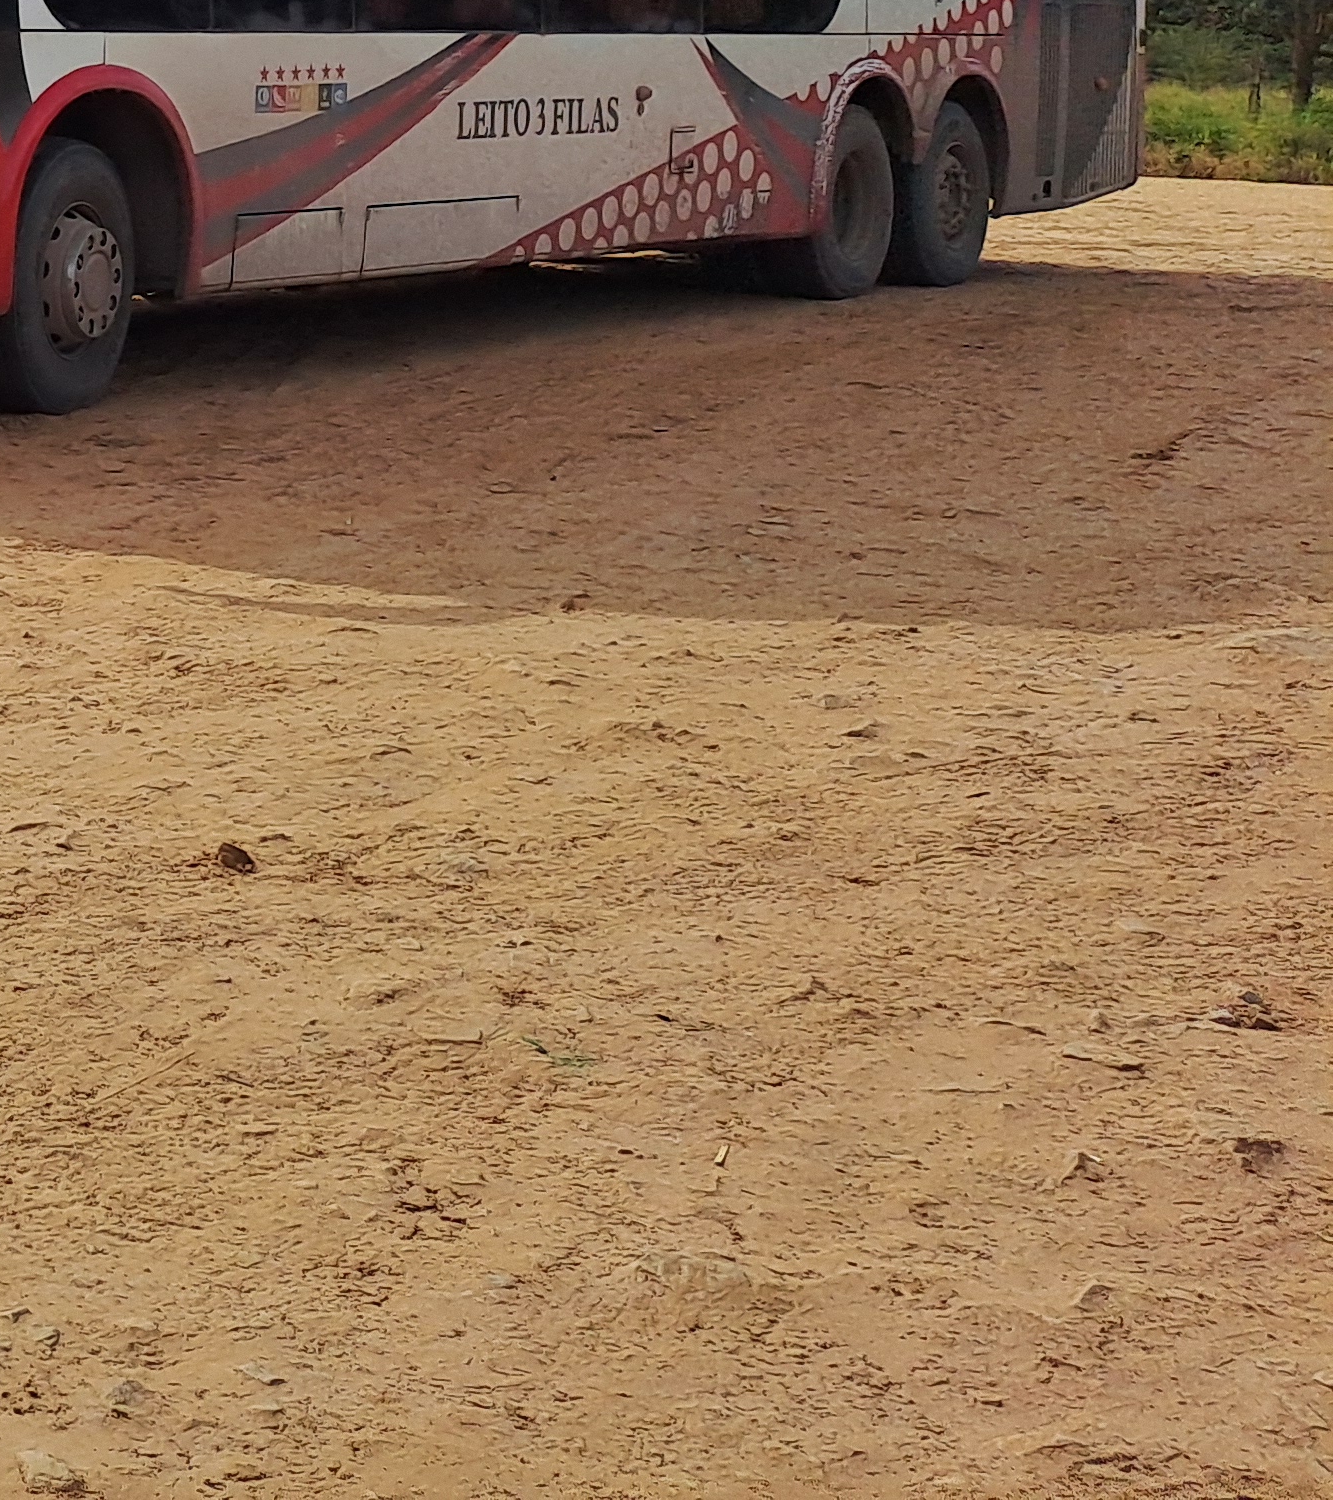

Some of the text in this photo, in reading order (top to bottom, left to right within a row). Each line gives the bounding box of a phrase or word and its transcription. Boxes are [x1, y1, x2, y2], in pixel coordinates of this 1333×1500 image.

[456, 96, 620, 140] LEITO 3 FILAS
